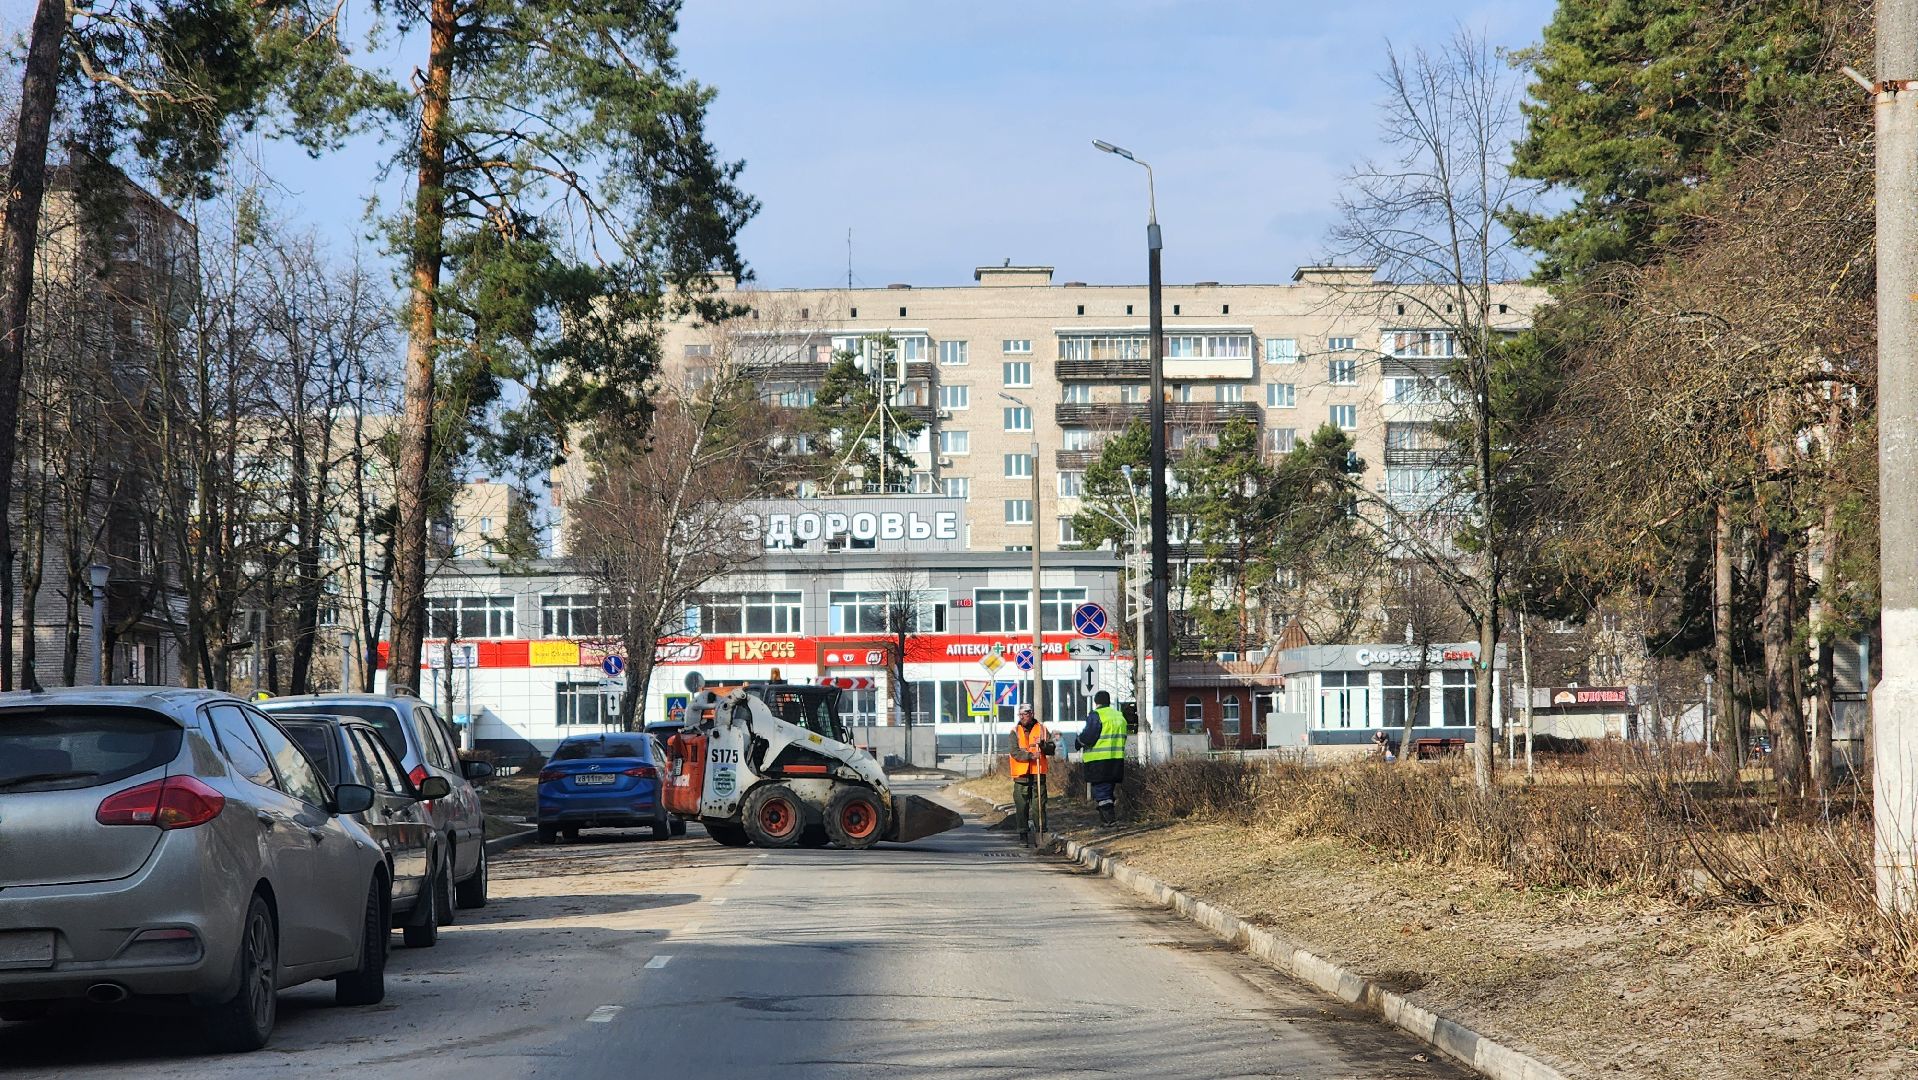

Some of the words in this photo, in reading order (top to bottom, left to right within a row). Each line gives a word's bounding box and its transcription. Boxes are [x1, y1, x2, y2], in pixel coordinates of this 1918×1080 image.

[738, 511, 957, 547] ЗДОРОВЬЕ
[725, 641, 764, 660] FIX
[761, 641, 795, 653] price
[946, 644, 990, 655] АПТЕКИ
[1007, 643, 1063, 654] ГОРЗРАВ
[711, 748, 739, 763] S175
